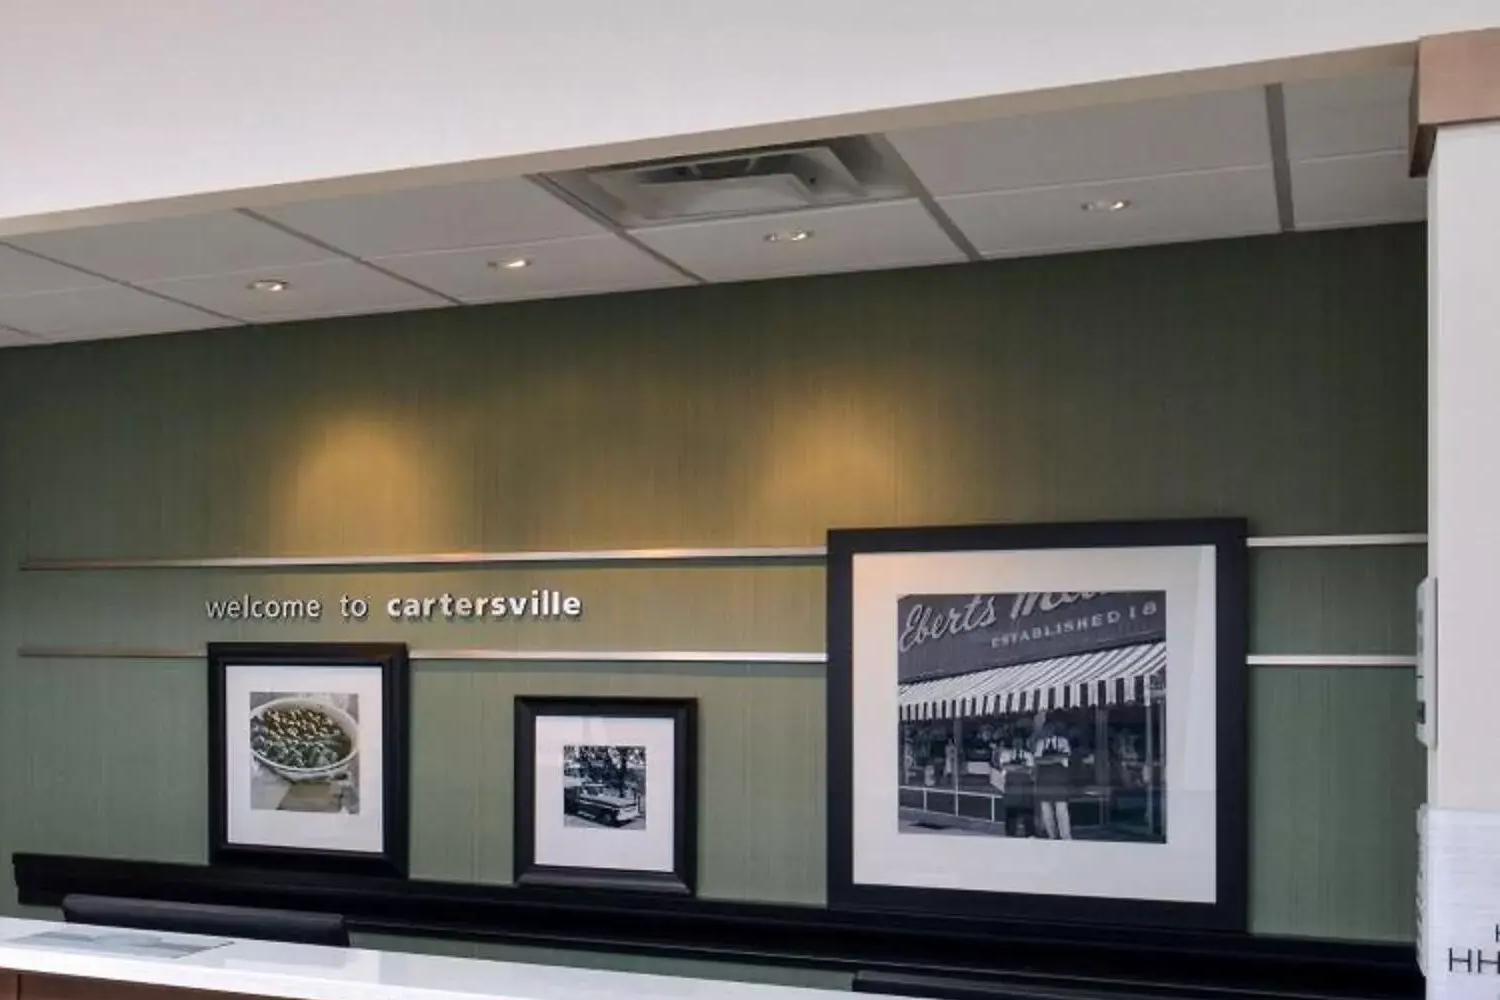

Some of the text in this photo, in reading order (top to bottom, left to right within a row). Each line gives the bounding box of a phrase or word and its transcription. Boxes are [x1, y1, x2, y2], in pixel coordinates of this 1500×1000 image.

[206, 589, 583, 619] welcome to cartersville
[900, 594, 997, 653] Eberts
[991, 610, 1122, 649] ESTABLISHED
